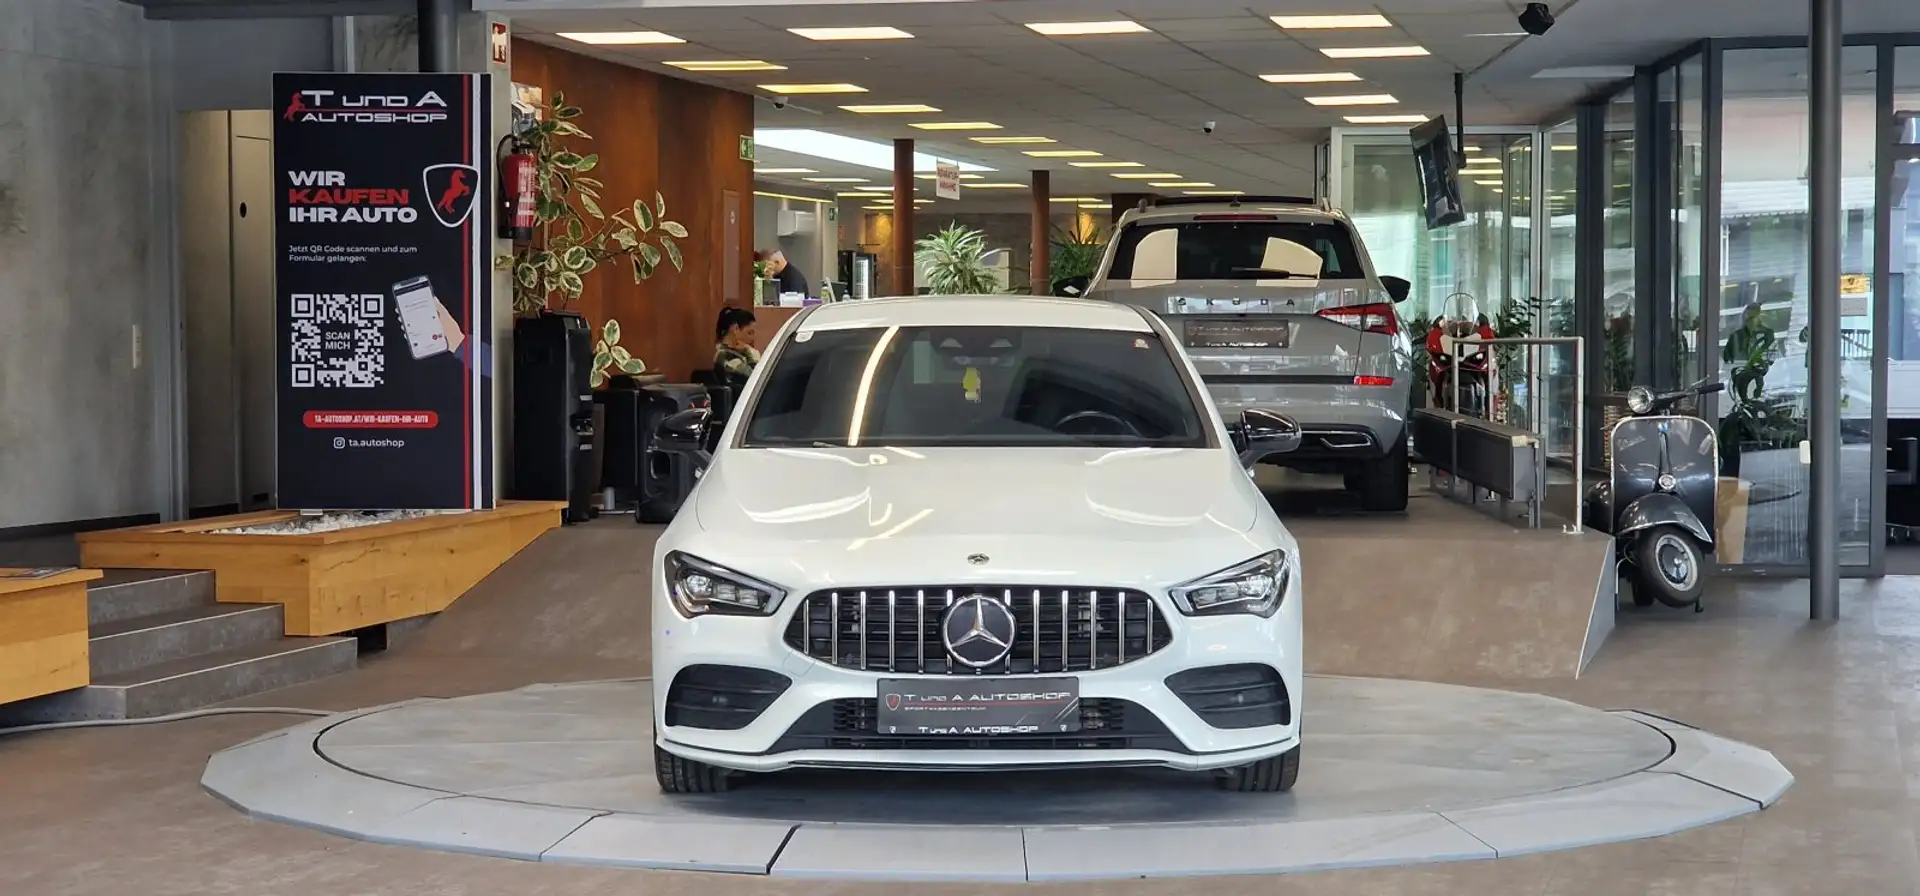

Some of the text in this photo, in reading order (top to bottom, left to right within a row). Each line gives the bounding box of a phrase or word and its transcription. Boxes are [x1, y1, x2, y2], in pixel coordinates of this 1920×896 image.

[301, 90, 334, 106] T
[415, 91, 447, 108] A
[301, 113, 448, 123] AUTOSHOP
[288, 171, 346, 186] WIR
[288, 188, 409, 205] KAUFEN
[289, 207, 418, 223] IHR AUTO
[289, 245, 308, 253] Jetzt
[310, 245, 322, 253] QR
[289, 254, 367, 263] Formular gelangen:
[325, 331, 350, 340] SCAN
[325, 341, 350, 349] MICH
[348, 438, 405, 448] ta.autoshop
[969, 692, 1071, 701] AUTOSHOP
[918, 726, 929, 734] T
[948, 726, 958, 734] A
[963, 725, 1039, 734] AUTOSHOP
